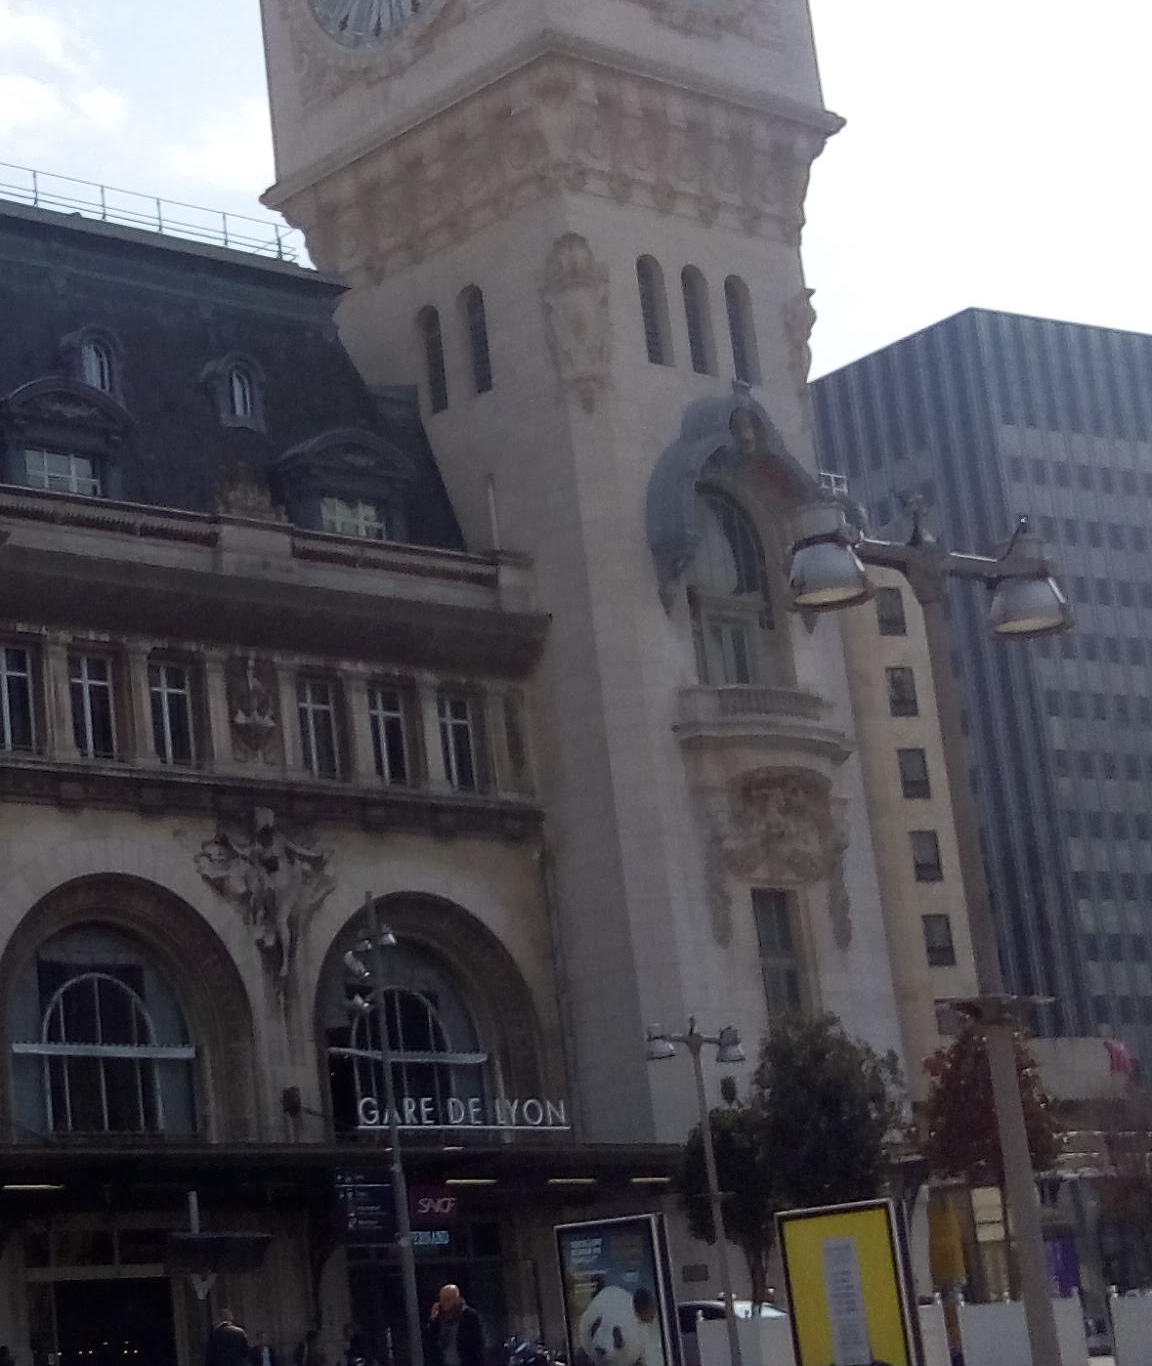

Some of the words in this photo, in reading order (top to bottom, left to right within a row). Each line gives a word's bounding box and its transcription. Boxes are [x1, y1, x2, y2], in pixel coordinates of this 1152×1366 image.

[358, 1096, 435, 1124] GARE
[448, 1097, 482, 1125] DE
[495, 1097, 567, 1125] LYON
[417, 1197, 456, 1214] SNCF
